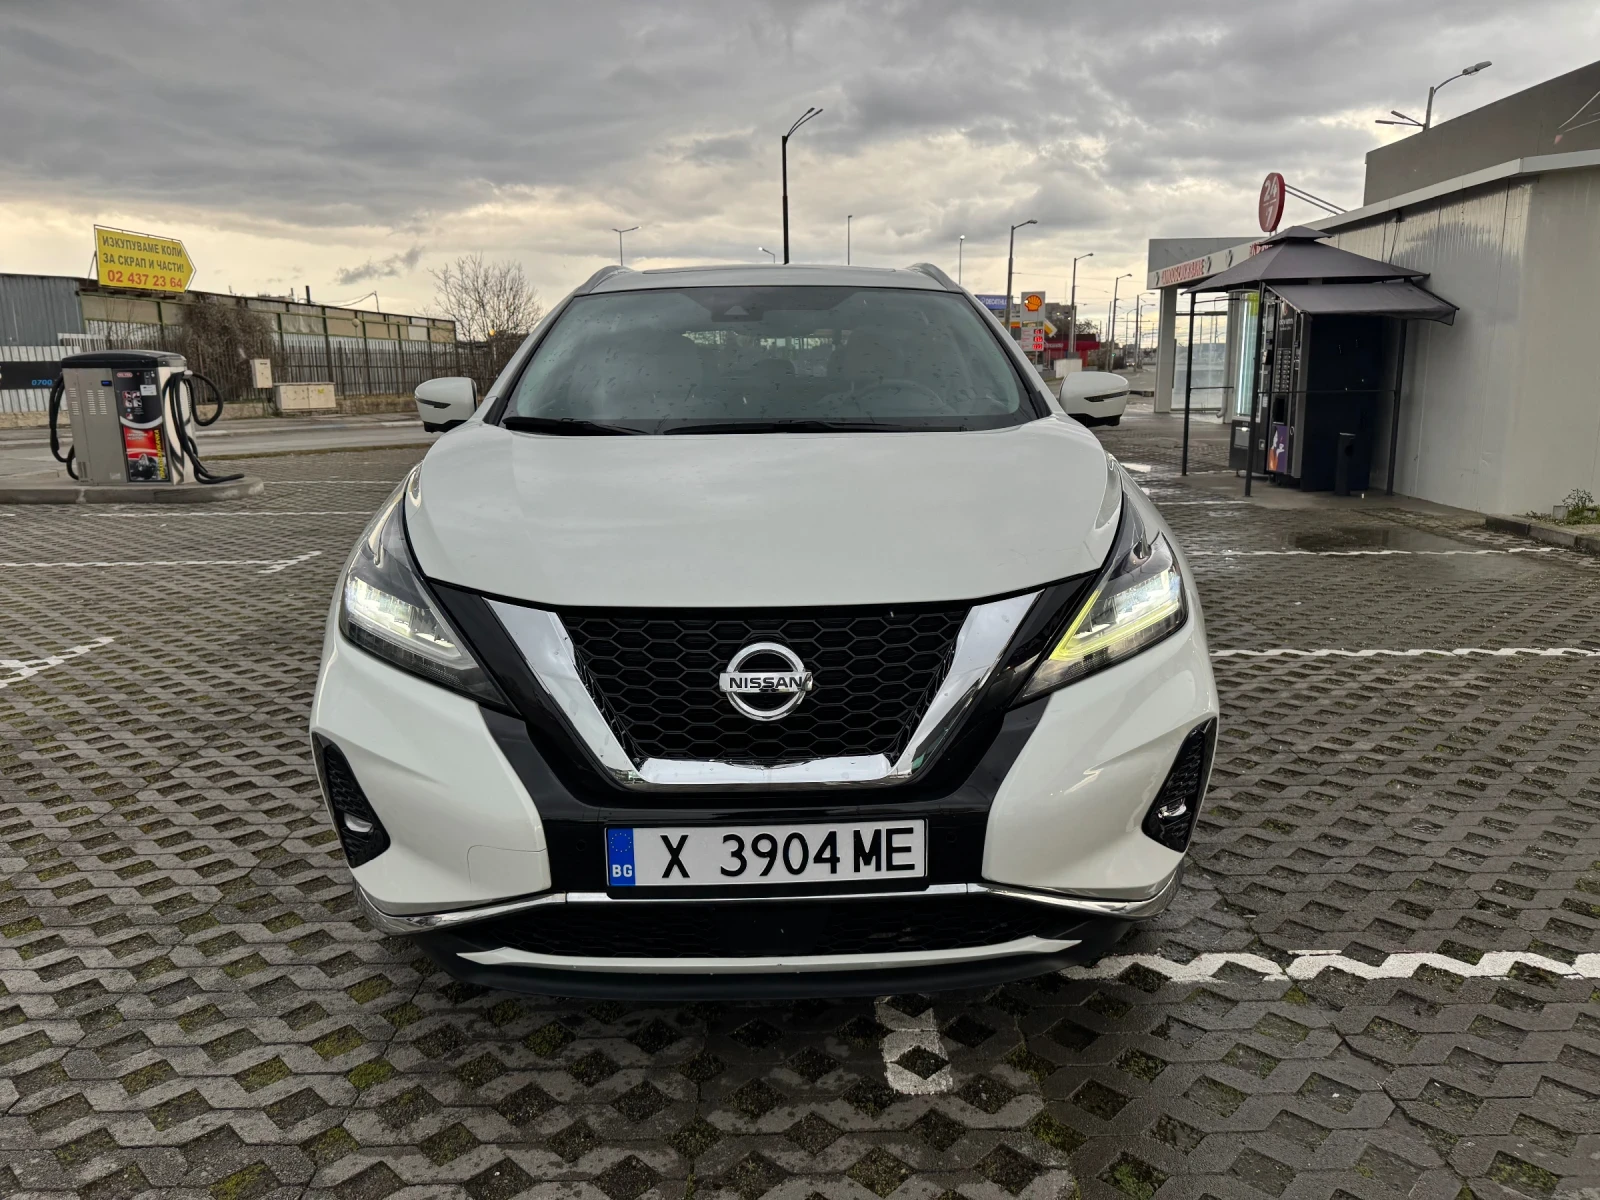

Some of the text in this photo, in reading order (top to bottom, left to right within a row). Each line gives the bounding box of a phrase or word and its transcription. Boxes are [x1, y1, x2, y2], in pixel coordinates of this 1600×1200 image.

[1264, 176, 1277, 201] 24
[1266, 206, 1273, 227] 7
[102, 235, 182, 258] ИЗКУПУВАМЕ КОЛИ
[103, 253, 184, 273] ЗА СКРАП И ЧАСТИ!
[107, 270, 182, 288] 02 437 23 64
[730, 677, 802, 688] NISSAN
[660, 827, 915, 879] X 3904 ME
[612, 864, 633, 878] BG
